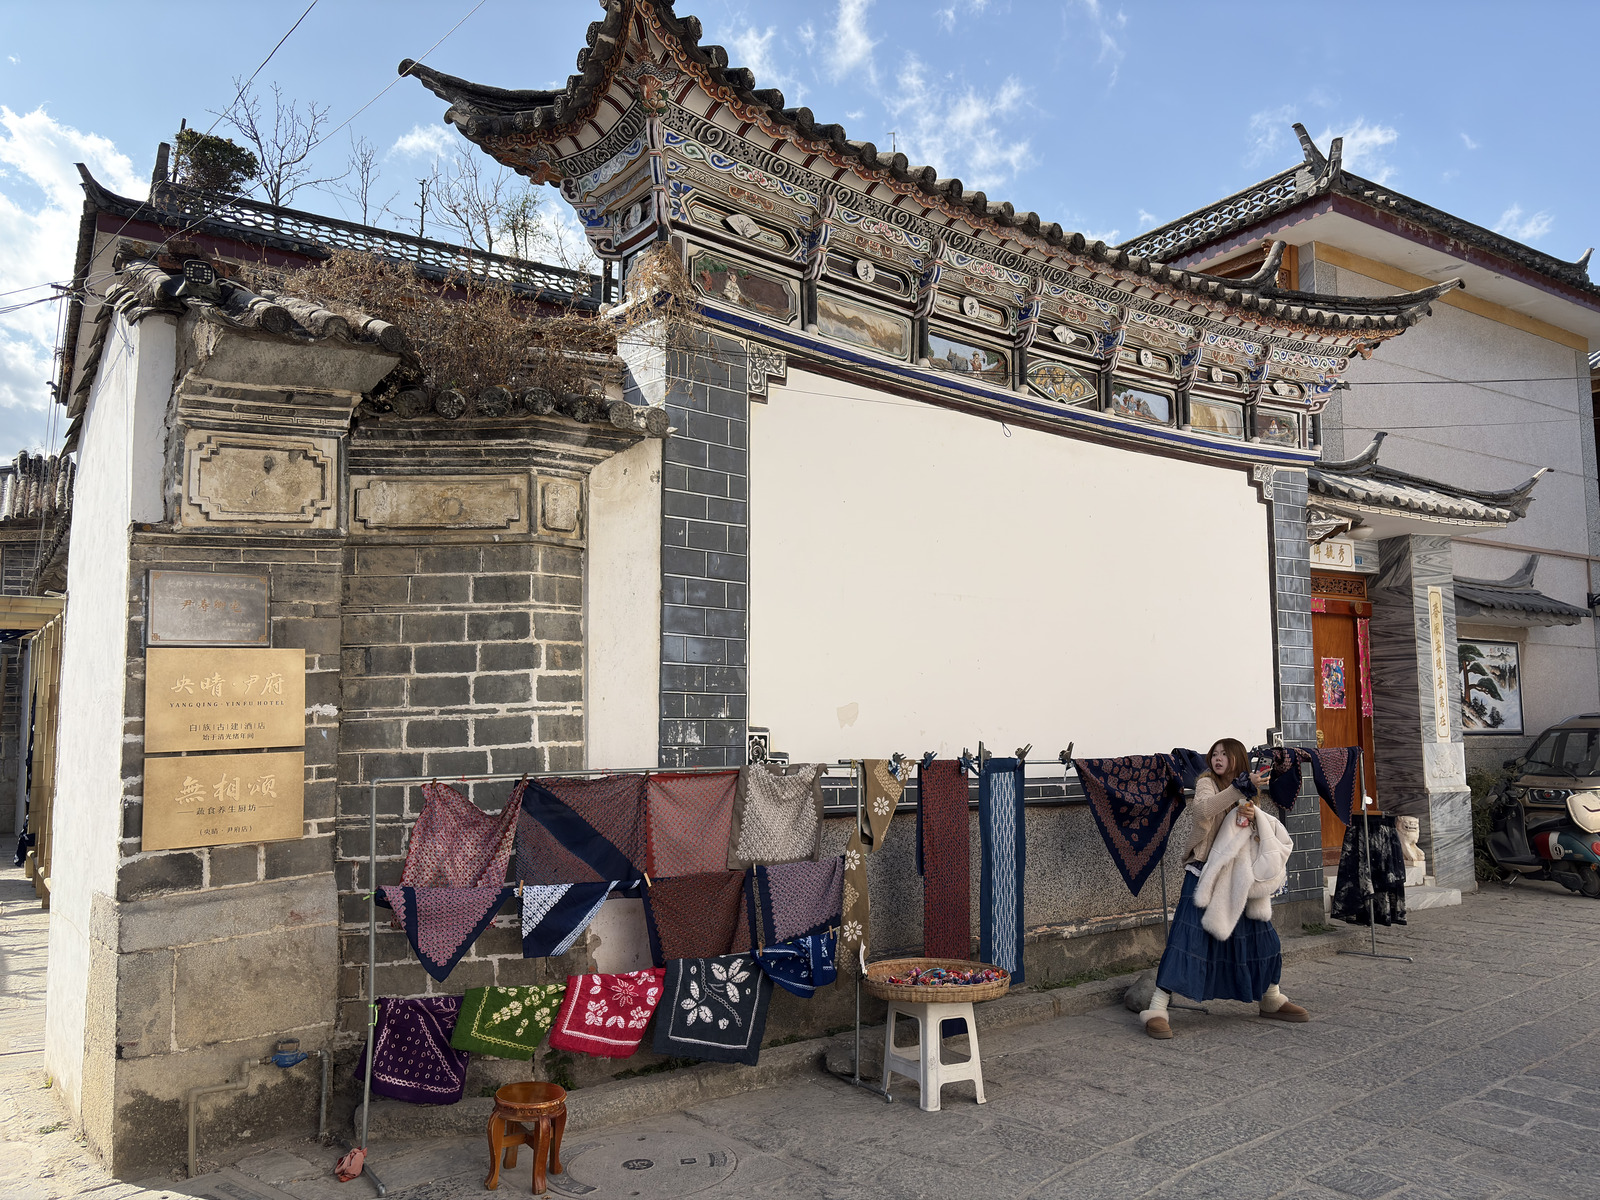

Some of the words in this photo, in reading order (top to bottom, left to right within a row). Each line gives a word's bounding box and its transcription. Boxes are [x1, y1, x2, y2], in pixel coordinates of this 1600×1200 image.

[202, 733, 255, 741] 始于清光绪年间
[174, 773, 278, 805] 無相颂
[196, 804, 256, 815] 蔬食养生厨坊
